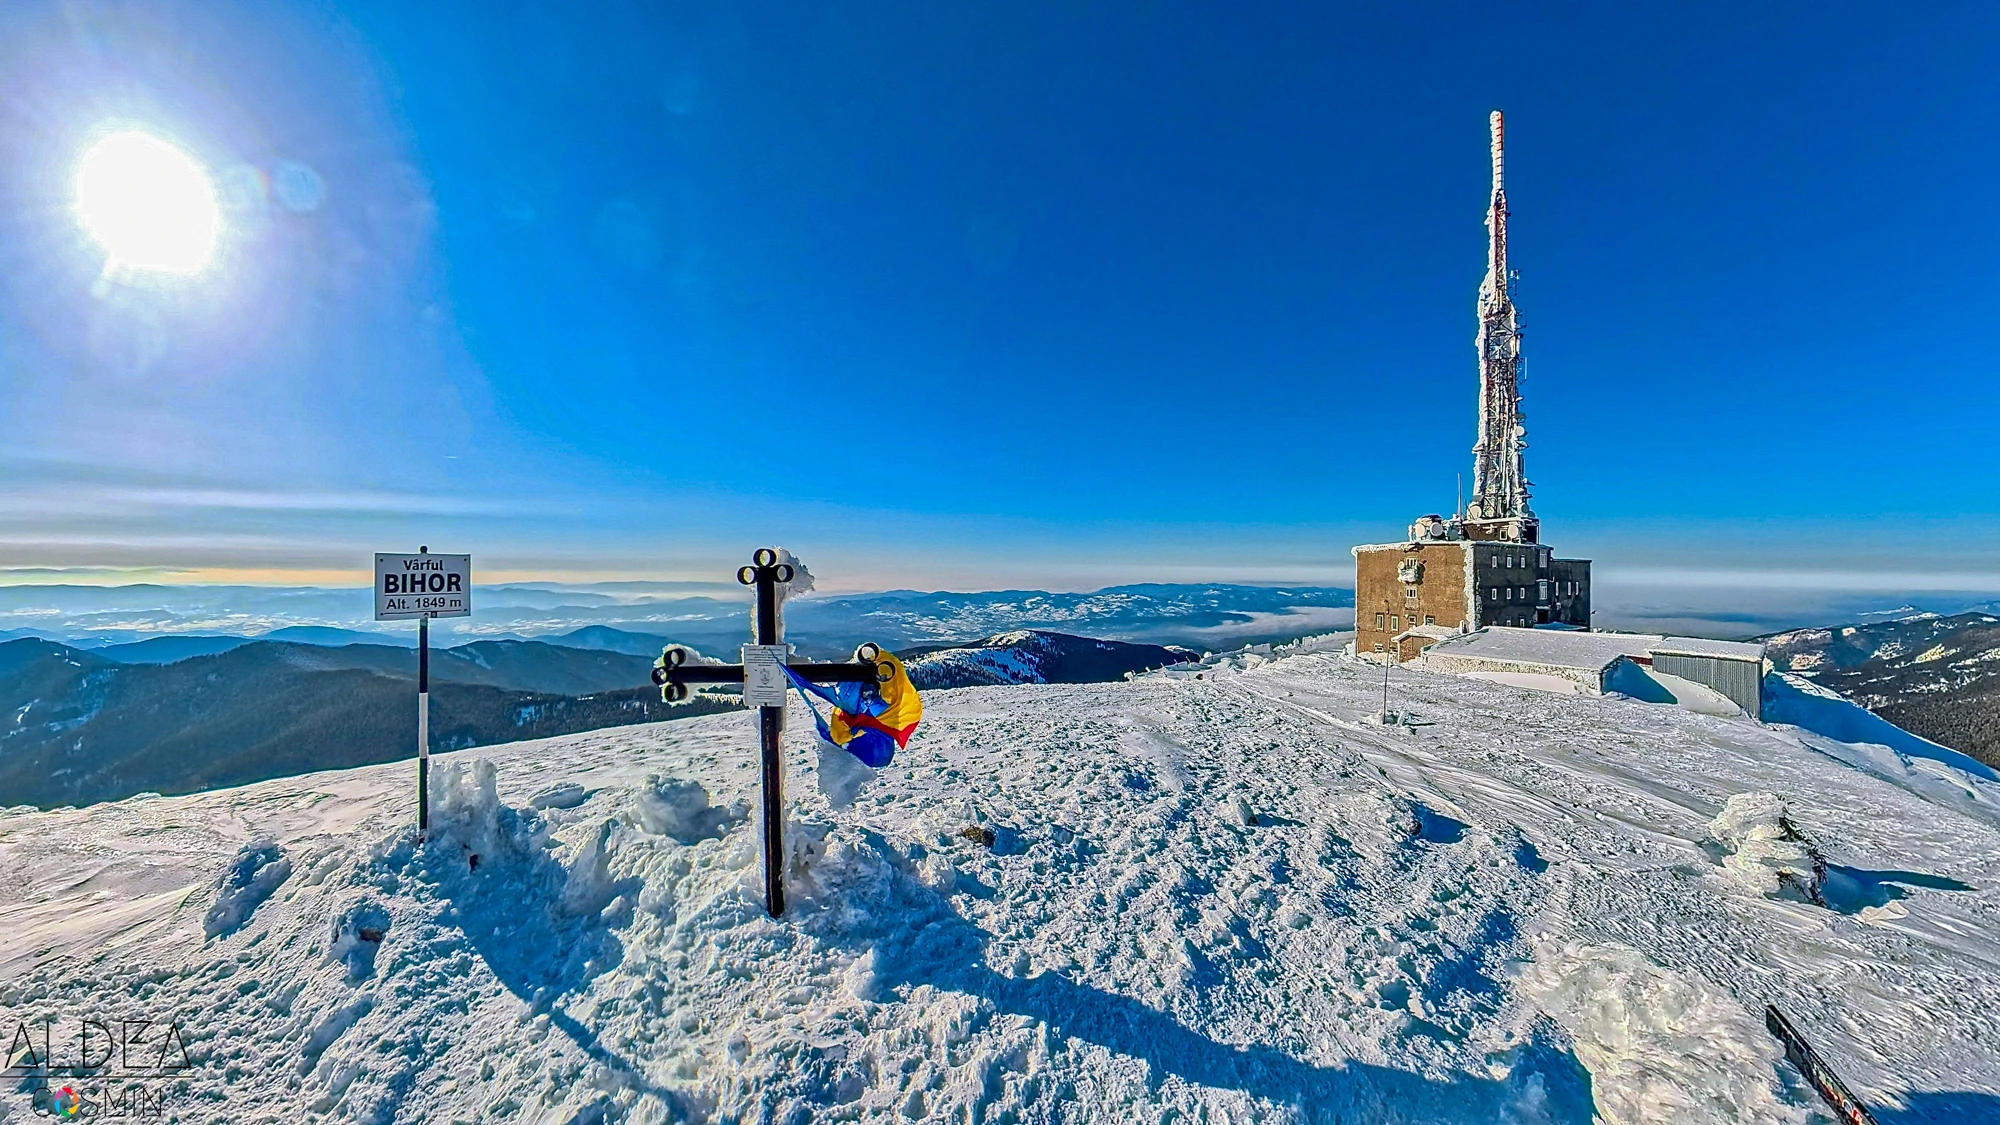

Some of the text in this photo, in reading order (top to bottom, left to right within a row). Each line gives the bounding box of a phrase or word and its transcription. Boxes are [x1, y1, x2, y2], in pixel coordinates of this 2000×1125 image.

[403, 559, 444, 571] Vârful
[384, 573, 462, 593] BIHOR
[386, 597, 462, 610] Alt. 1849 m
